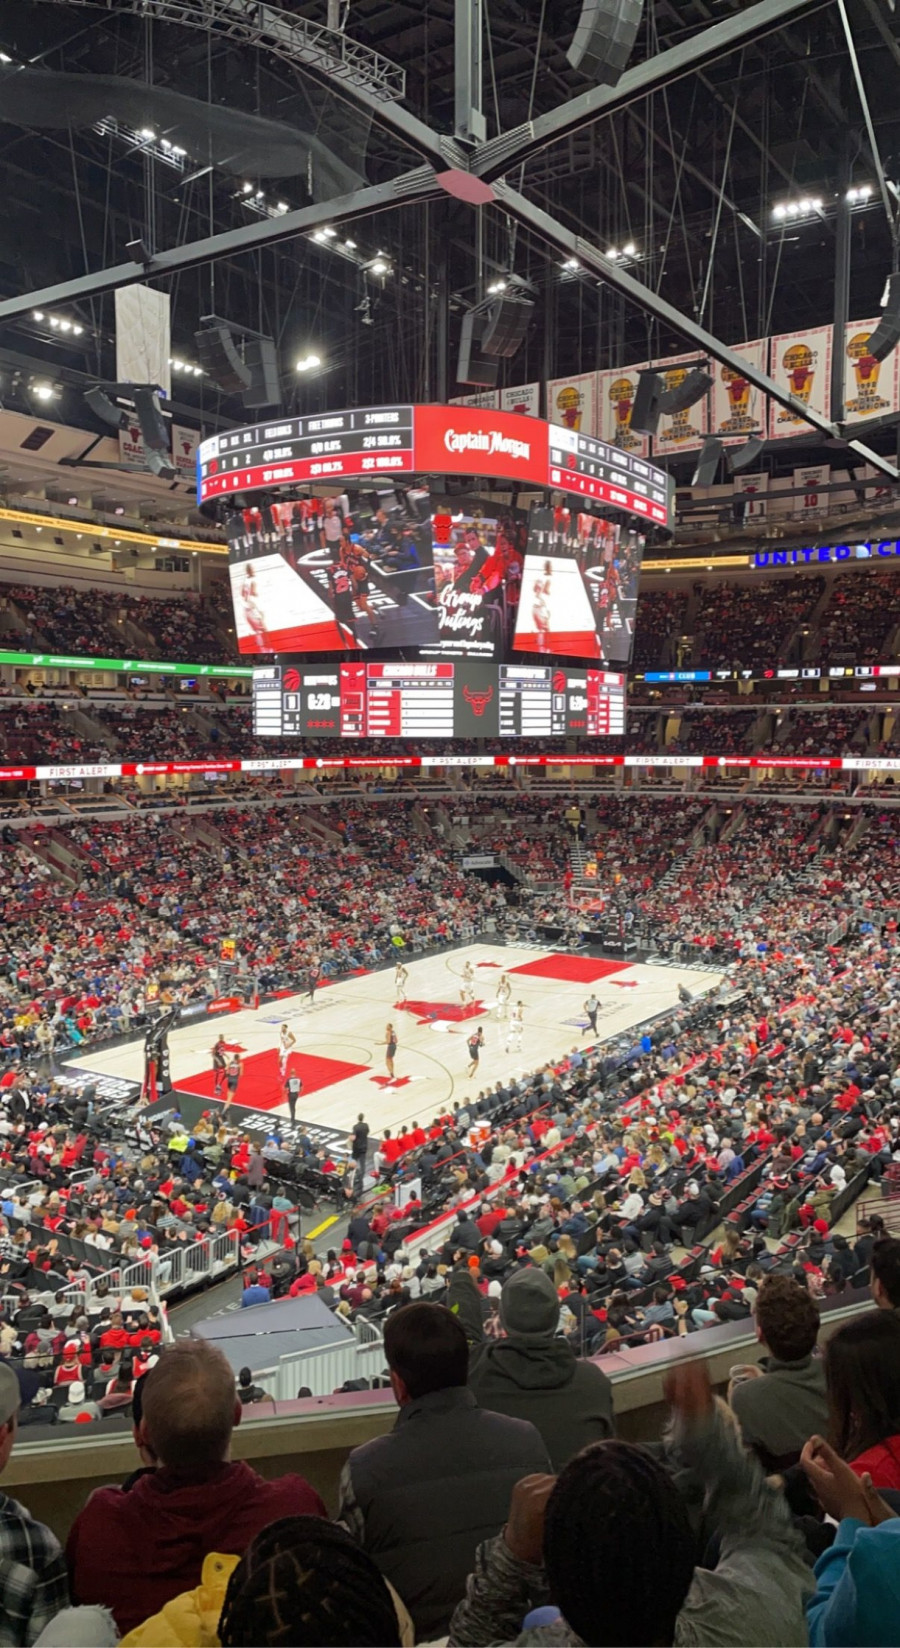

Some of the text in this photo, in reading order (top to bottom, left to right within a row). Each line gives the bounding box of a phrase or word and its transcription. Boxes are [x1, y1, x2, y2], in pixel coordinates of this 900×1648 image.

[784, 350, 818, 361] CHICAGO
[363, 436, 376, 448] 2/4
[444, 428, 489, 453] Captain
[487, 430, 530, 460] Morgan
[804, 495, 818, 507] 10
[754, 545, 851, 567] UNITED
[439, 583, 483, 611] Group
[678, 671, 696, 680] CLUB
[855, 760, 881, 768] FIRST
[50, 766, 108, 777] FIRST ALERT
